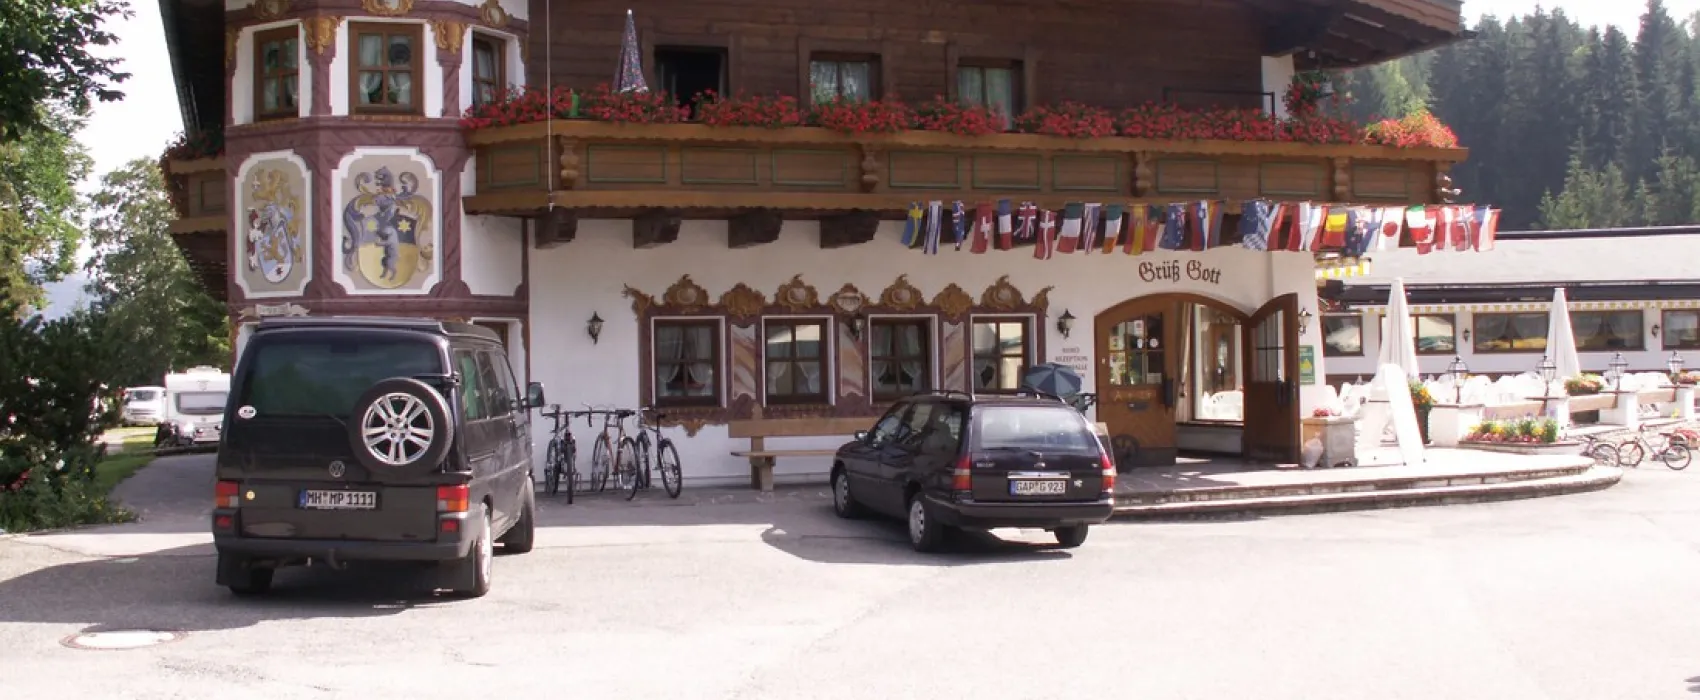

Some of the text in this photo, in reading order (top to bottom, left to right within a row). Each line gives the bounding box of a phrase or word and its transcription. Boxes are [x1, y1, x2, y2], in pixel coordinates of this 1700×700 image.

[1139, 260, 1221, 284] Grüß Gott
[1016, 481, 1034, 492] GAP
[1047, 481, 1064, 493] 923
[346, 493, 373, 505] 1111
